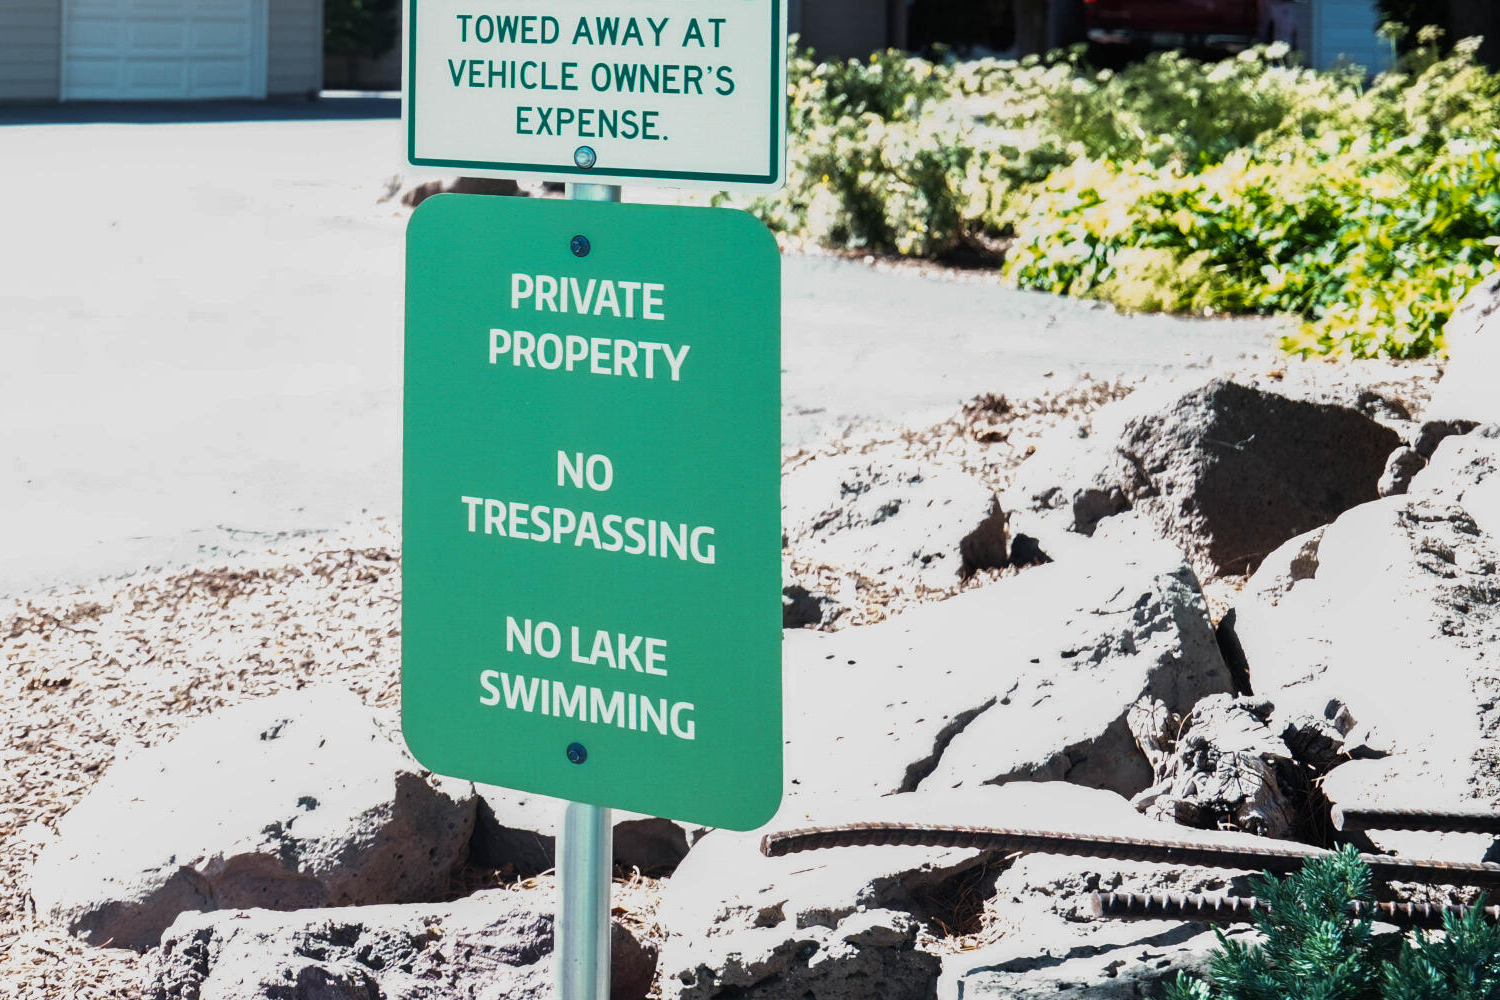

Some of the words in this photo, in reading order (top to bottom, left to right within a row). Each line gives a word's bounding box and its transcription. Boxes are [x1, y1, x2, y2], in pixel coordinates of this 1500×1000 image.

[456, 15, 559, 44] TOWED
[572, 17, 669, 46] AWAY
[682, 18, 726, 48] AT
[448, 59, 578, 91] VEHICLE
[591, 63, 734, 96] OWNER'S
[516, 106, 668, 141] EXPENSE.
[510, 273, 665, 320] PRIVATE
[488, 329, 690, 381] PROPERTY
[556, 450, 613, 492] NO
[461, 496, 716, 565] TRESPASSING
[505, 616, 561, 659] NO
[571, 626, 667, 677] LAKE
[479, 669, 695, 740] SWIMMING
